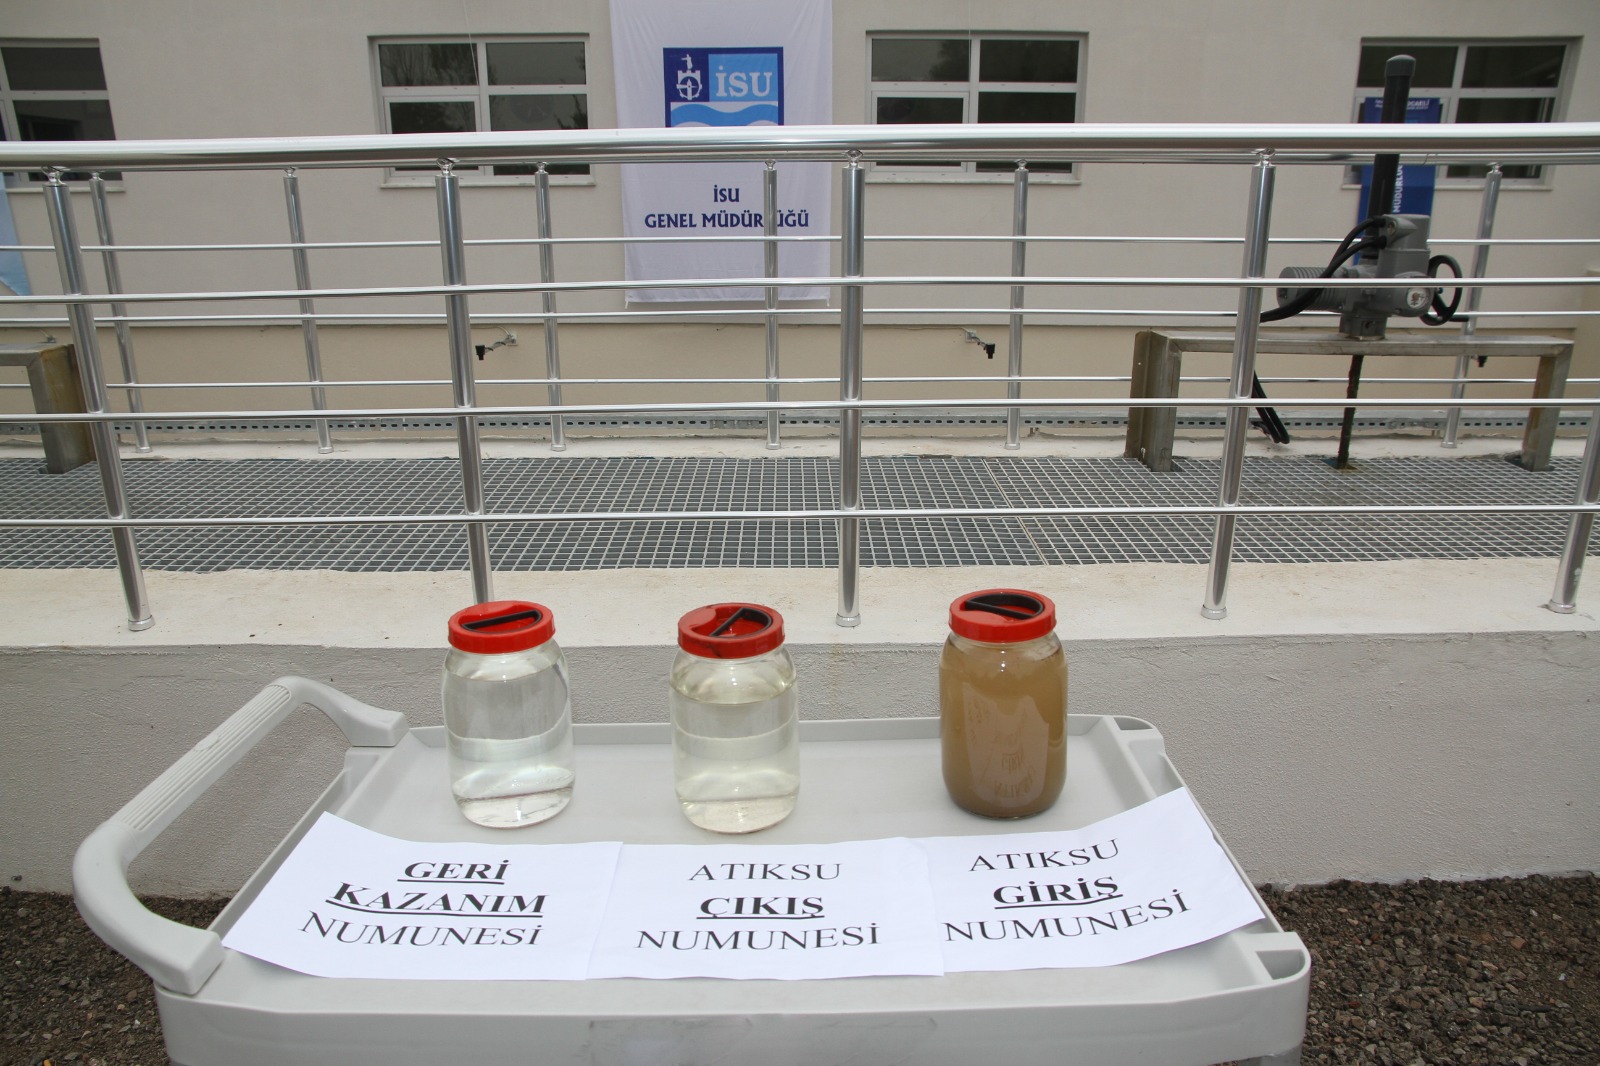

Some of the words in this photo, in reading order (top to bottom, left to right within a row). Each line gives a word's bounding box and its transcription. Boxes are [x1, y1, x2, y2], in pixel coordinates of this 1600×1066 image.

[715, 65, 773, 98] İSU
[713, 184, 740, 203] İSU
[644, 213, 697, 229] GENEL
[702, 209, 809, 228] MÜDÜRÜĞÜ
[968, 838, 1120, 872] ATIKSU
[403, 859, 511, 881] GERİ
[688, 863, 842, 881] ATIKSU
[332, 882, 549, 914] KAZANIM
[993, 876, 1120, 905] GİRİŞ
[699, 896, 825, 918] ÇIKIŞ
[942, 888, 1192, 942] NUMUNESİ
[298, 910, 544, 947] NUMUNESİ
[634, 922, 881, 951] NUMUNESİ
